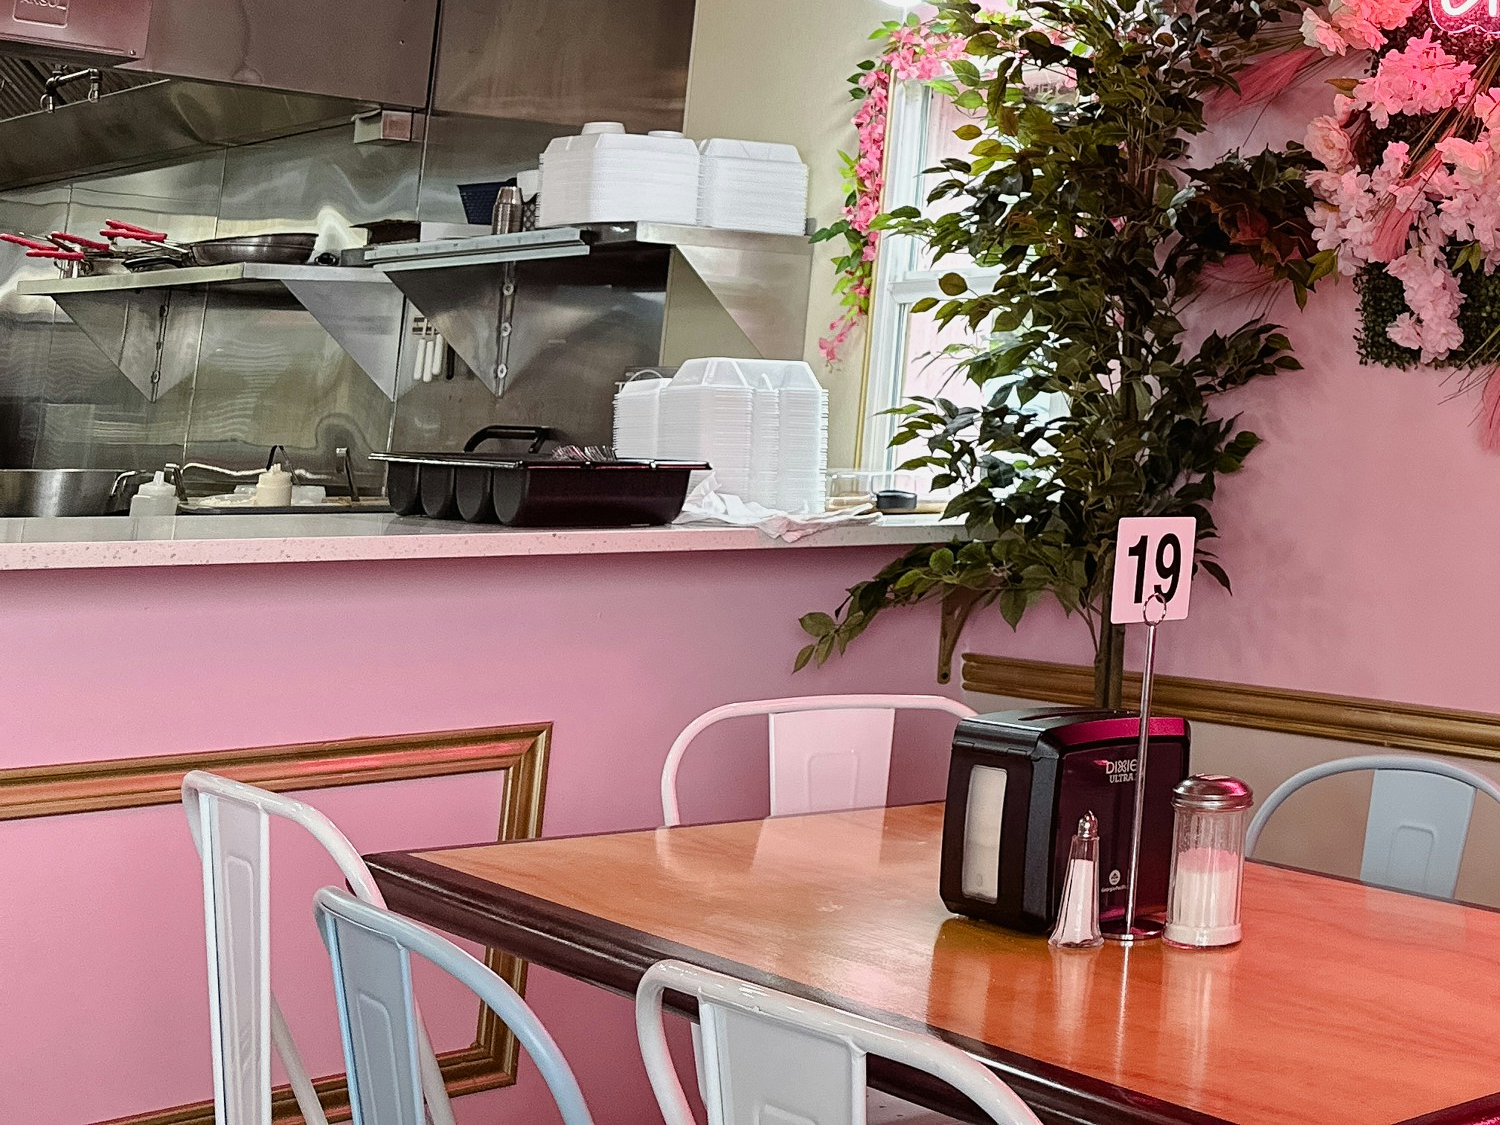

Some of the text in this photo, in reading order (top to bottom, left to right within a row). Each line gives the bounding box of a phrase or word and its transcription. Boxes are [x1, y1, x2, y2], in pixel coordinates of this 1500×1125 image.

[1128, 533, 1181, 604] 19
[1105, 759, 1138, 775] DIXIE
[1109, 773, 1134, 784] ULTRA
